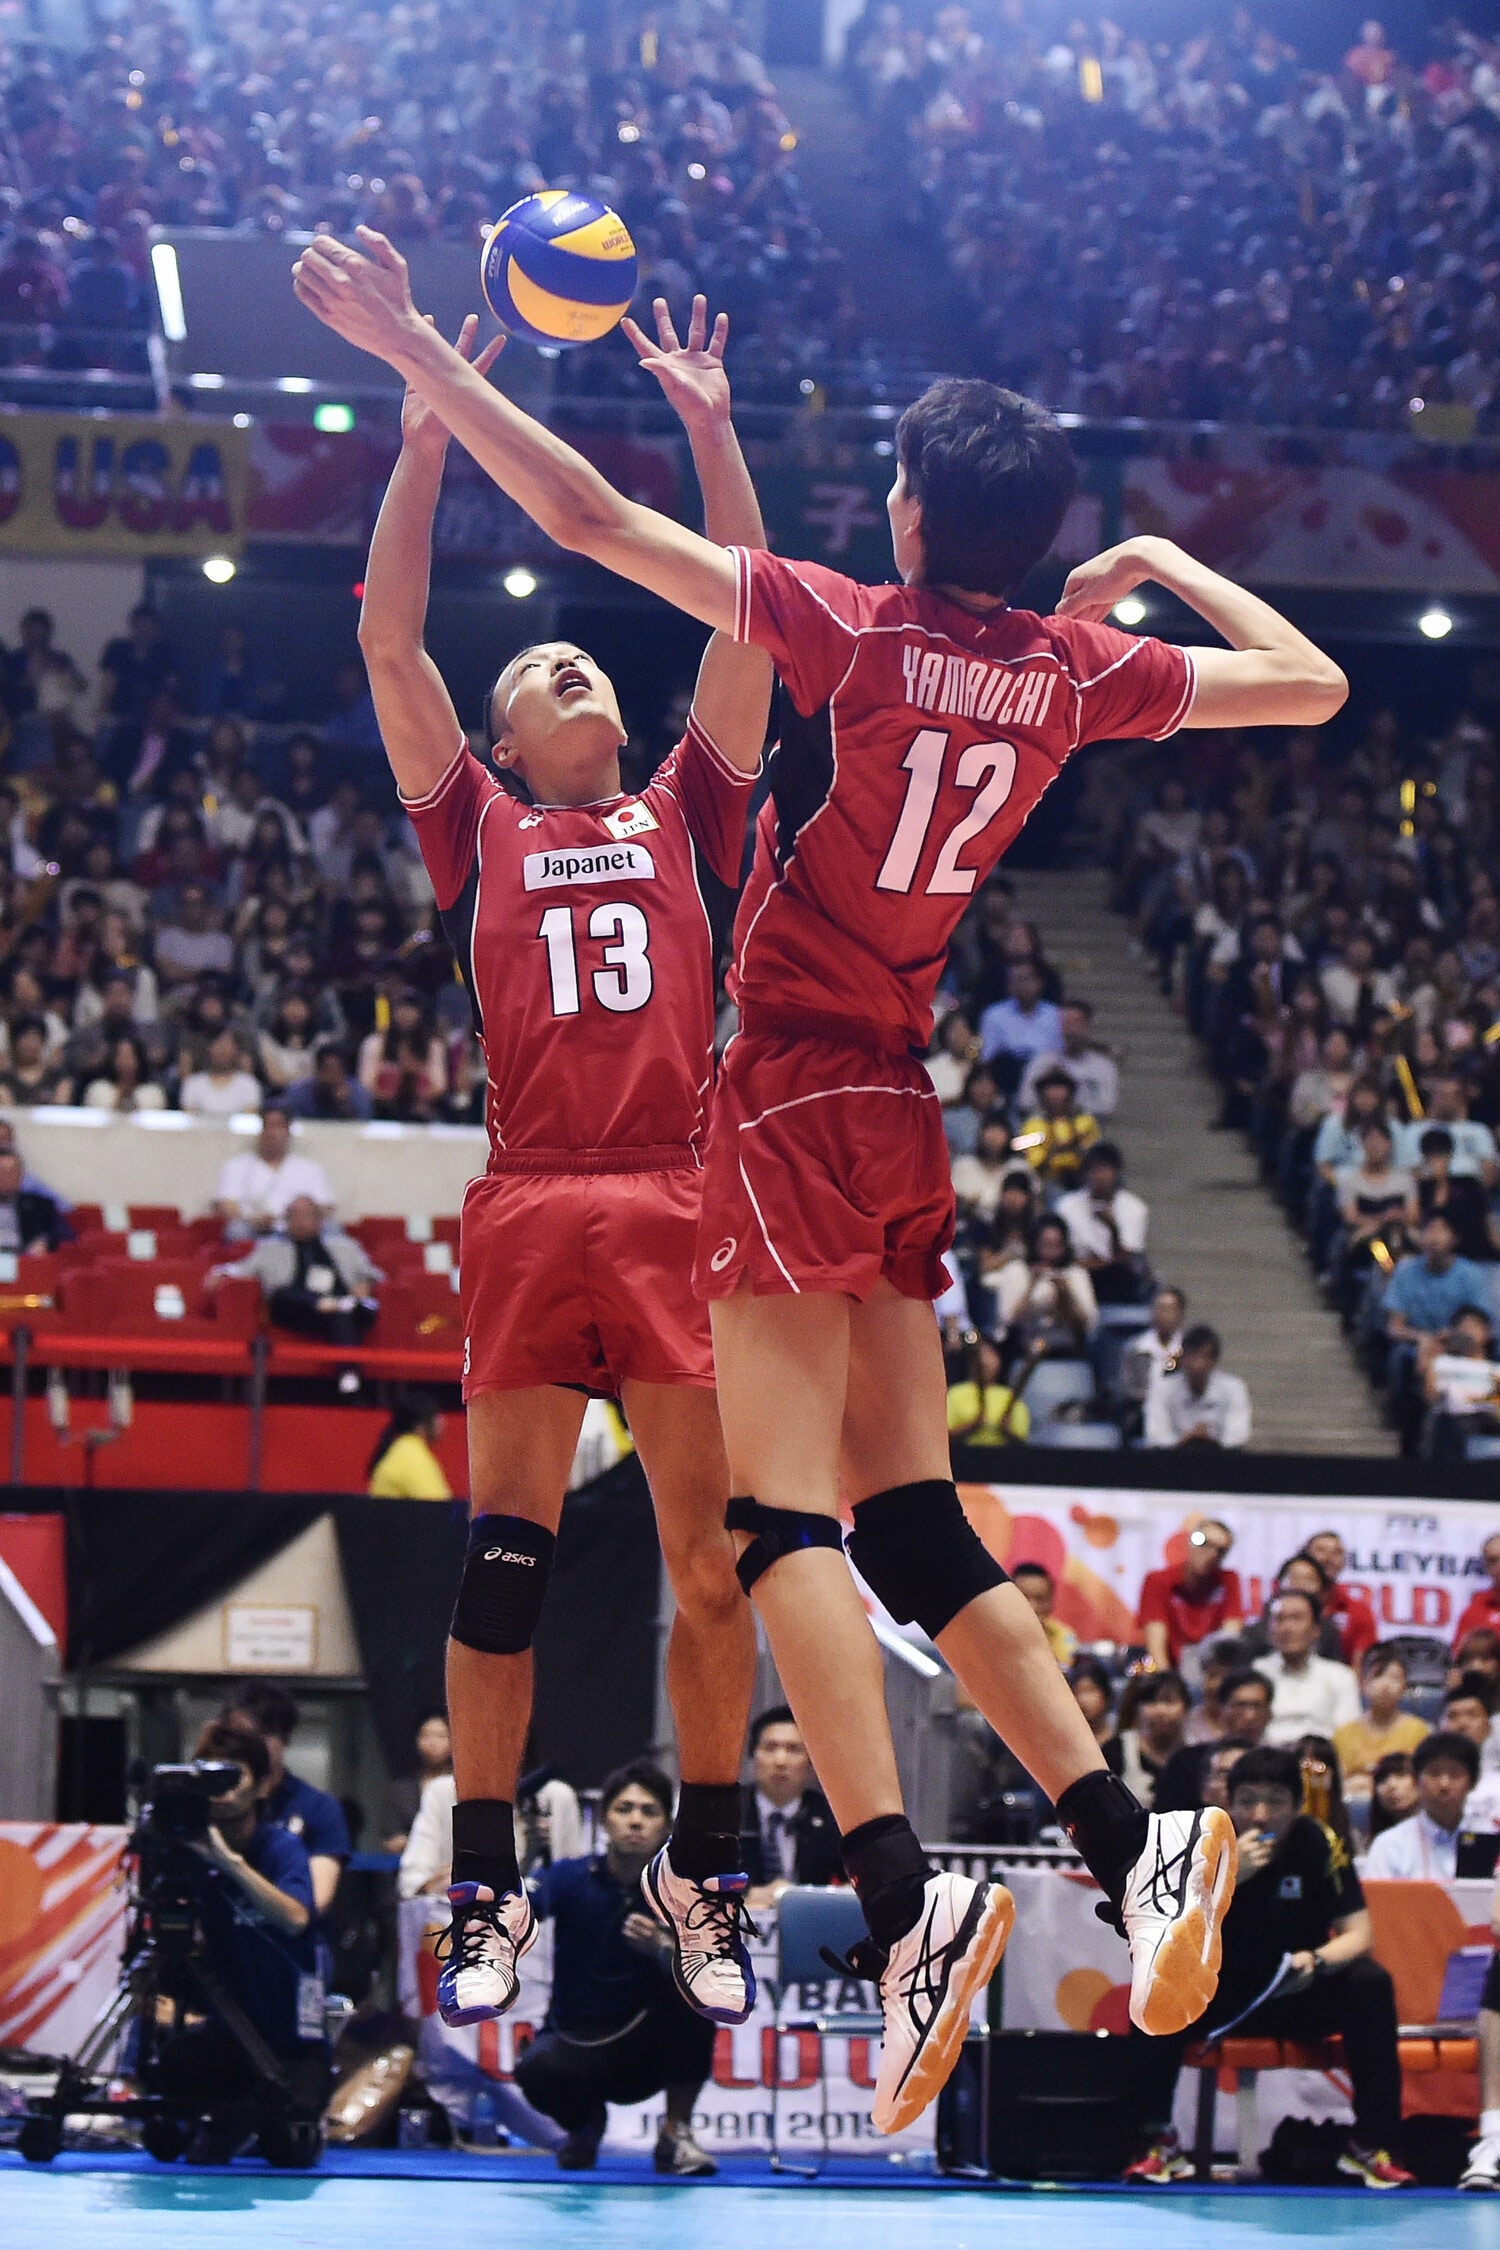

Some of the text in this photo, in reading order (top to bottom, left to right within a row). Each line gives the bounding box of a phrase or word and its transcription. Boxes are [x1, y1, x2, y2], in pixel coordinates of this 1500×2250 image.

[55, 434, 233, 535] USA
[903, 645, 1058, 727] YAMAUCHI
[622, 820, 650, 836] JPN
[876, 728, 1017, 894] 12
[541, 850, 636, 879] Japanet
[537, 902, 653, 1016] 13
[501, 1551, 537, 1567] asics
[1346, 1549, 1486, 1577] LLEYBA
